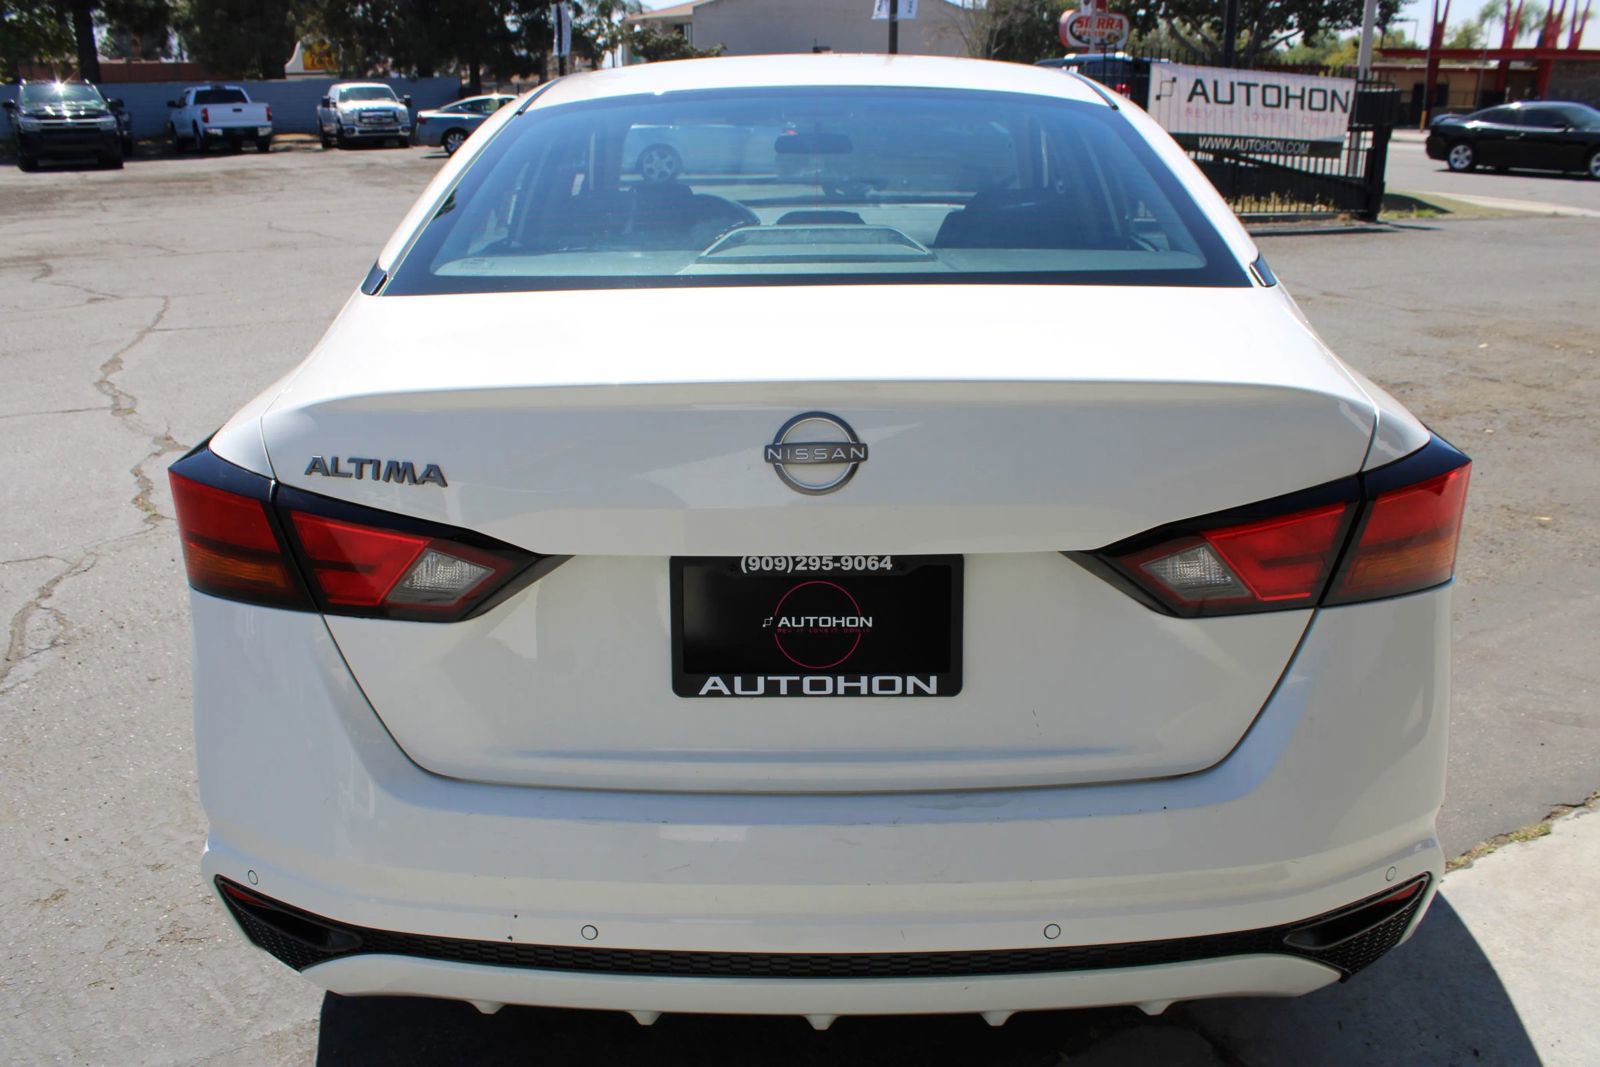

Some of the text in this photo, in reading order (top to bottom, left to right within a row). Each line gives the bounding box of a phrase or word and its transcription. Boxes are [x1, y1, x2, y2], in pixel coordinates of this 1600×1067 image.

[1187, 78, 1350, 114] AUTOHON
[1199, 136, 1310, 154] WWW.AUTOHON.COM
[767, 447, 865, 460] NISSAN
[304, 455, 448, 487] ALTIMA
[740, 556, 893, 573] (909)295-9064
[777, 616, 873, 628] AUTOHON
[698, 675, 938, 695] AUTOHON
